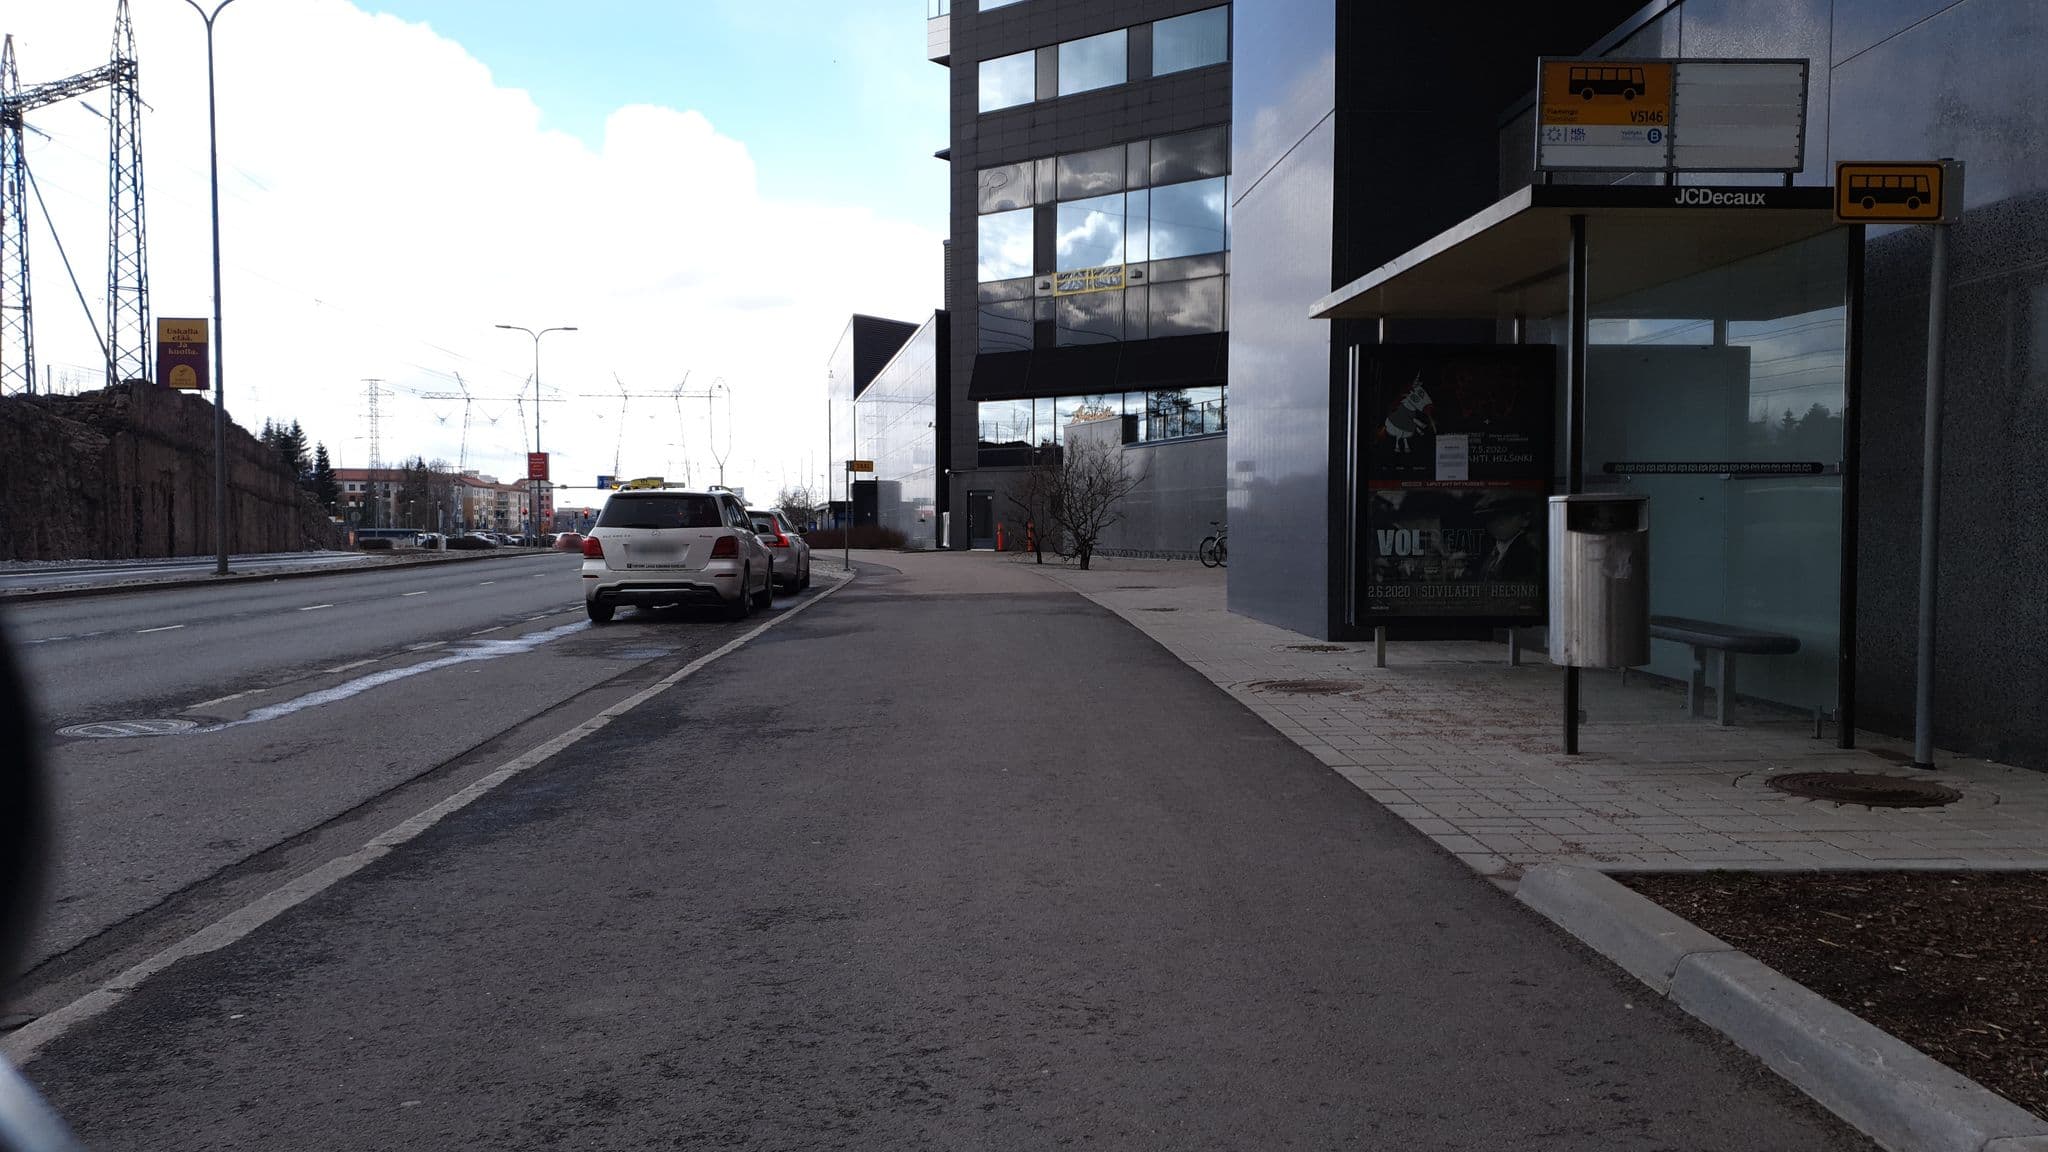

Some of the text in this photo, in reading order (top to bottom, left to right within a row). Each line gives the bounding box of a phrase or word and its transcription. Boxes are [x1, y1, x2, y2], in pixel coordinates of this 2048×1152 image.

[1630, 110, 1663, 122] V5146
[1674, 188, 1766, 206] JCDecaux
[1492, 455, 1533, 463] HELSINKI
[1368, 584, 1539, 598] 2.6.2020 SUVILAHTI HELSINKI
